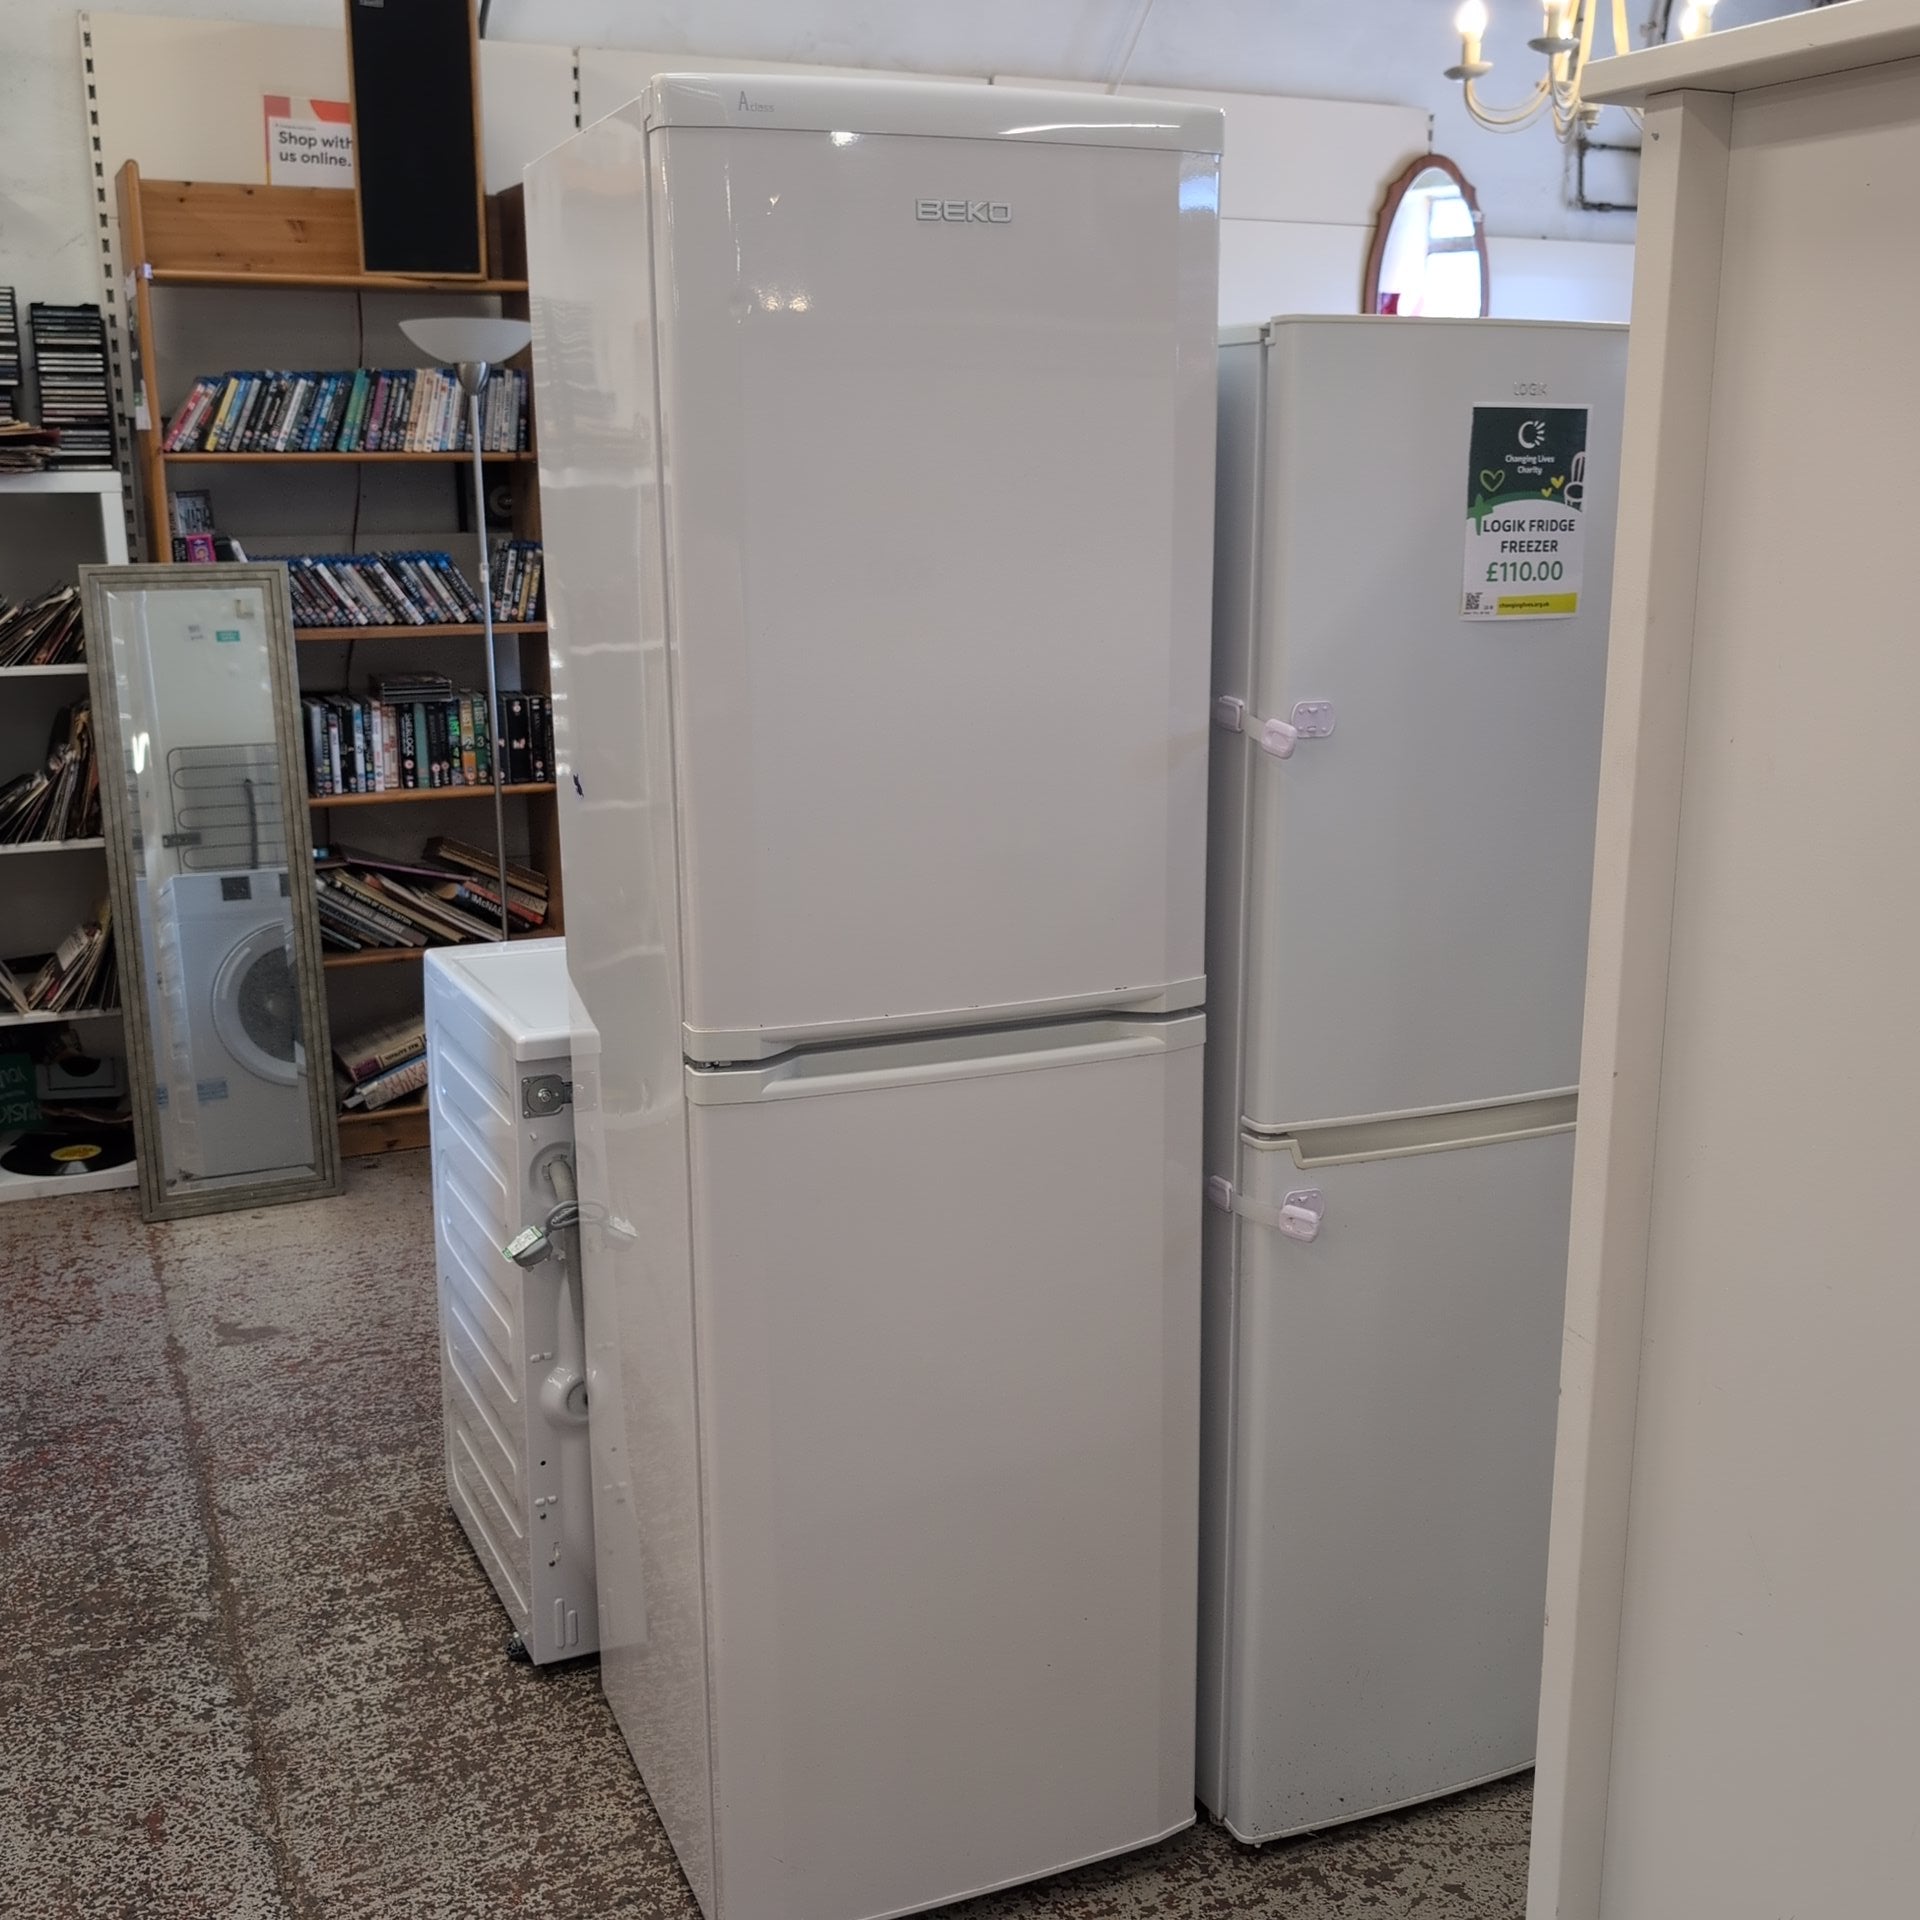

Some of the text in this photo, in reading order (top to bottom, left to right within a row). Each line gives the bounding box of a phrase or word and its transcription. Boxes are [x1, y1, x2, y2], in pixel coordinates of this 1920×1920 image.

[279, 131, 318, 149] Shop
[279, 152, 352, 167] us online.
[915, 199, 1012, 224] BEKO
[1513, 382, 1548, 397] LOGIK
[1505, 454, 1555, 465] Changing Lives
[1517, 465, 1543, 476] Charity
[1482, 519, 1576, 532] LOGIK FRIDGE
[1500, 540, 1558, 553] FREEZER
[1486, 561, 1564, 582] £110.00
[404, 712, 414, 757] SHERLOCK
